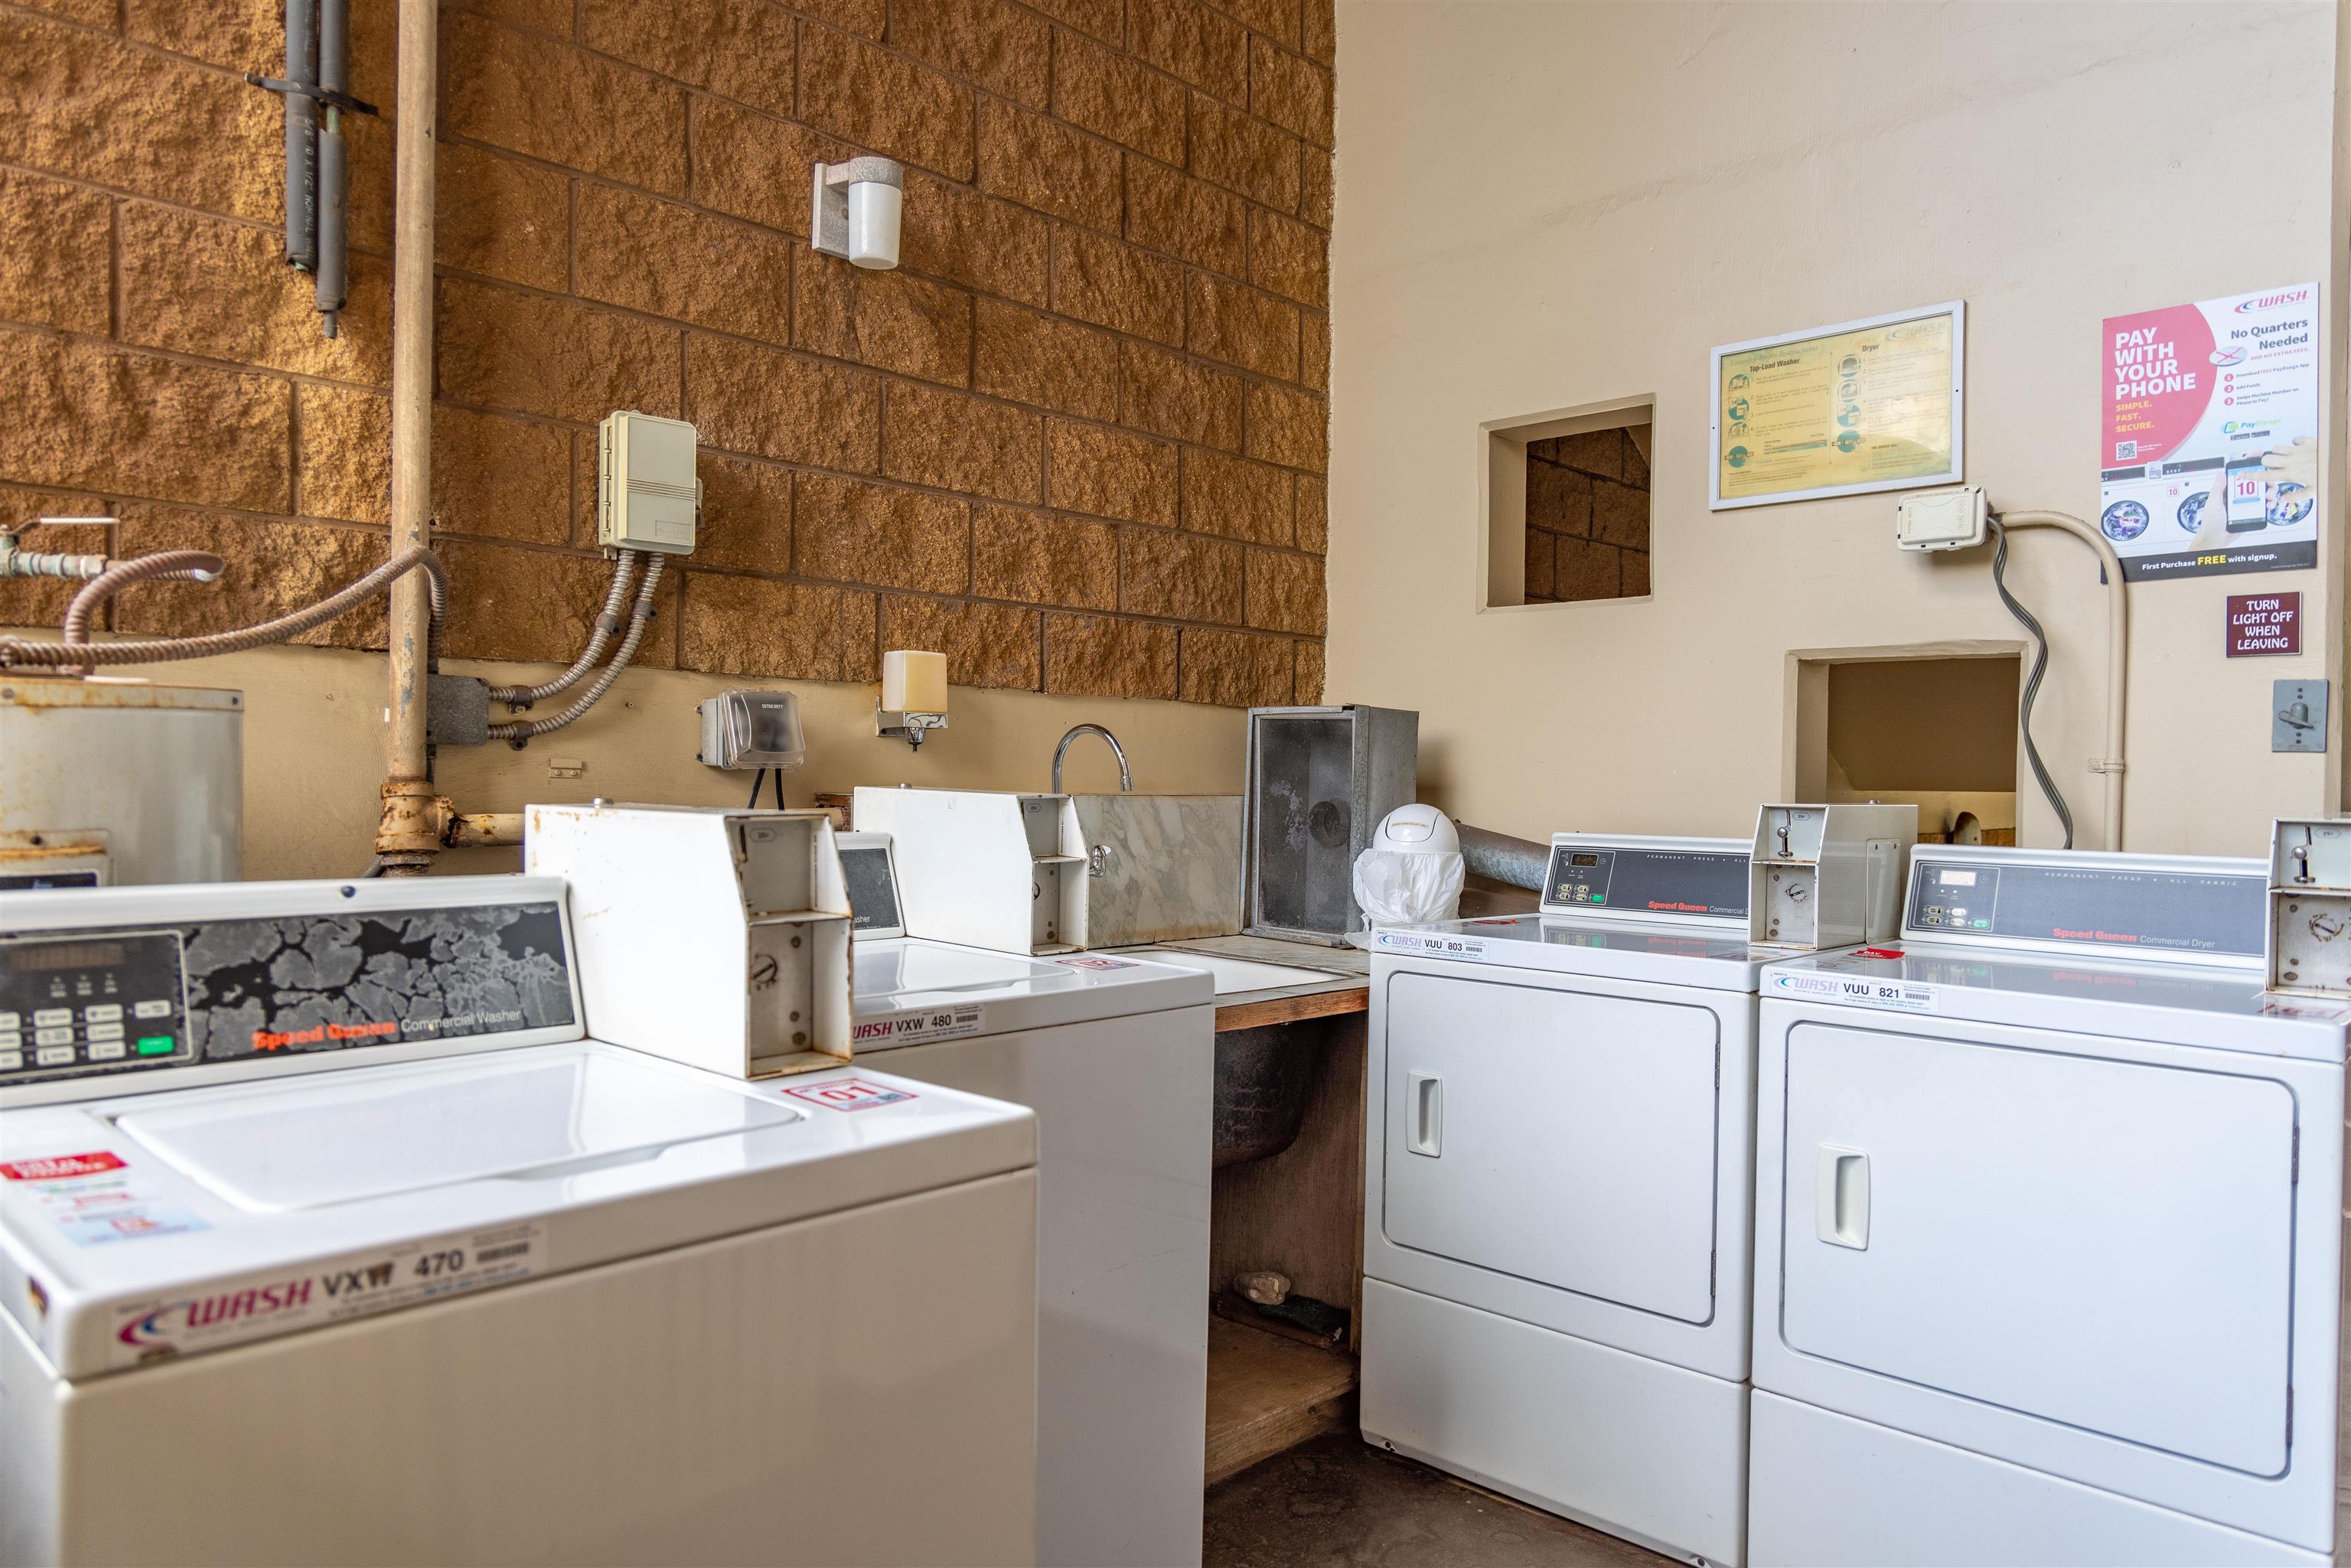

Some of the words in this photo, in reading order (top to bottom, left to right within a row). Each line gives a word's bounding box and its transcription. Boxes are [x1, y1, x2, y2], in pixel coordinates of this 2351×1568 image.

[2258, 290, 2307, 308] WASH
[2231, 330, 2248, 339] No
[2251, 319, 2308, 337] Quarters
[2115, 327, 2157, 349] PAY
[2259, 333, 2308, 350] Needed
[1862, 344, 1880, 352] Dryer
[2115, 341, 2173, 366] WITH
[1749, 361, 1775, 373] Top-Load
[1776, 358, 1800, 367] Washer
[2115, 359, 2177, 383] YOUR
[2115, 373, 2196, 400] PHONE
[2116, 400, 2153, 412] SIMPLE.
[2116, 412, 2141, 422] FAST.
[2116, 422, 2155, 432] SECURE.
[2237, 481, 2255, 495] 10
[2142, 562, 2160, 570] First
[2160, 559, 2196, 569] Purchase
[2197, 555, 2226, 566] FREE
[2228, 554, 2246, 563] with
[2247, 553, 2278, 563] signup.
[2247, 599, 2279, 611] TURN
[2233, 613, 2268, 625] LIGHT
[2271, 611, 2294, 622] OFF
[2245, 624, 2280, 637] WHEN
[2237, 637, 2288, 650] LEAVING
[1648, 900, 1678, 910] Speed
[1678, 902, 1707, 912] Queen
[1709, 905, 1744, 914] Commercial
[853, 914, 870, 924] asher
[1392, 935, 1422, 947] WASH
[1424, 939, 1443, 949] VUU
[1448, 942, 1462, 952] 803
[2052, 927, 2093, 939] Speed
[2095, 930, 2137, 943] Queen
[2140, 934, 2190, 946] Commercial
[2192, 938, 2216, 950] Dryer
[1795, 978, 1839, 993] WASH
[1844, 983, 1870, 995] VUU
[1879, 987, 1899, 999] 821
[252, 1024, 323, 1051] Speed
[401, 1015, 474, 1034] Commercial
[476, 1009, 522, 1024] Washer
[896, 1018, 924, 1032] VXW
[931, 1014, 951, 1028] 480
[820, 1086, 878, 1101] 01
[185, 1278, 313, 1328] WASH
[323, 1261, 395, 1298] VXW
[414, 1249, 465, 1277] 470
